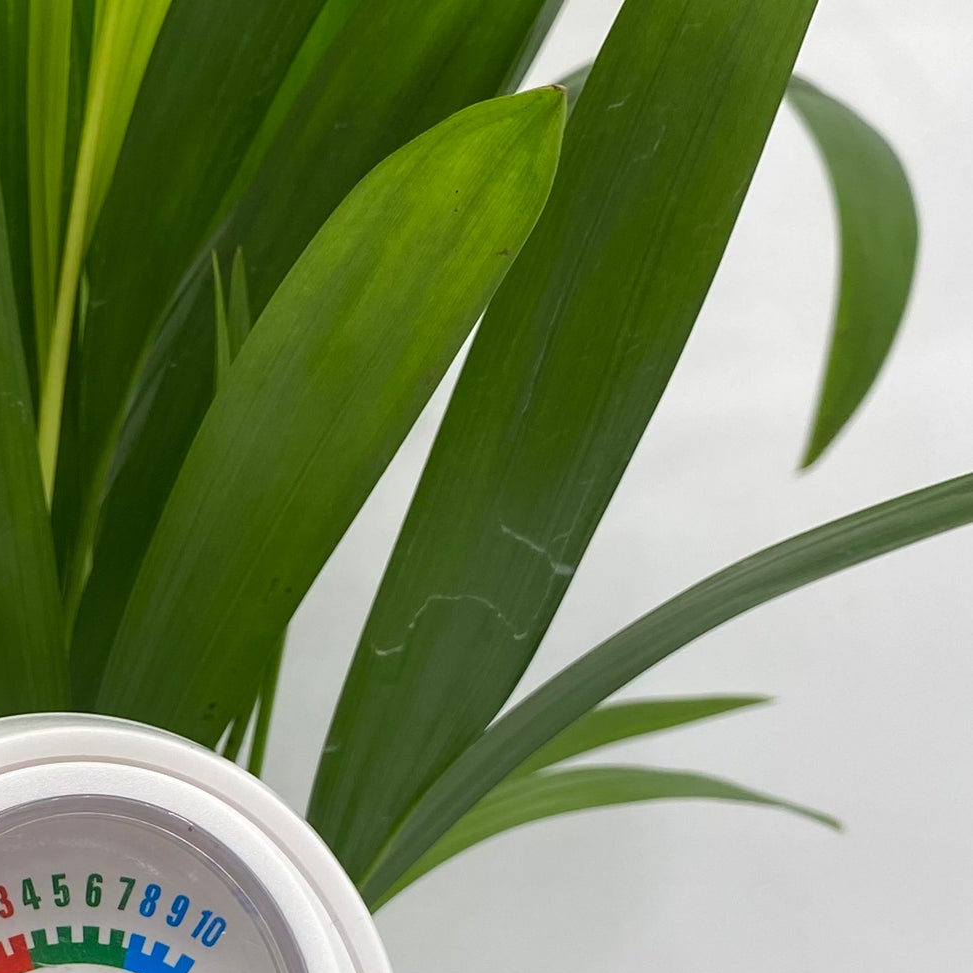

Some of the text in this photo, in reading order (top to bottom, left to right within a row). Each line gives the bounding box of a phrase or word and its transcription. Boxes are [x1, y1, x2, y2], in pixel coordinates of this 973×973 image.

[21, 877, 41, 910] 4
[51, 873, 70, 907] 5
[85, 873, 103, 907] 6
[118, 876, 136, 910] 7
[139, 884, 161, 917] 8
[166, 894, 190, 927] 9
[191, 910, 226, 947] 10
